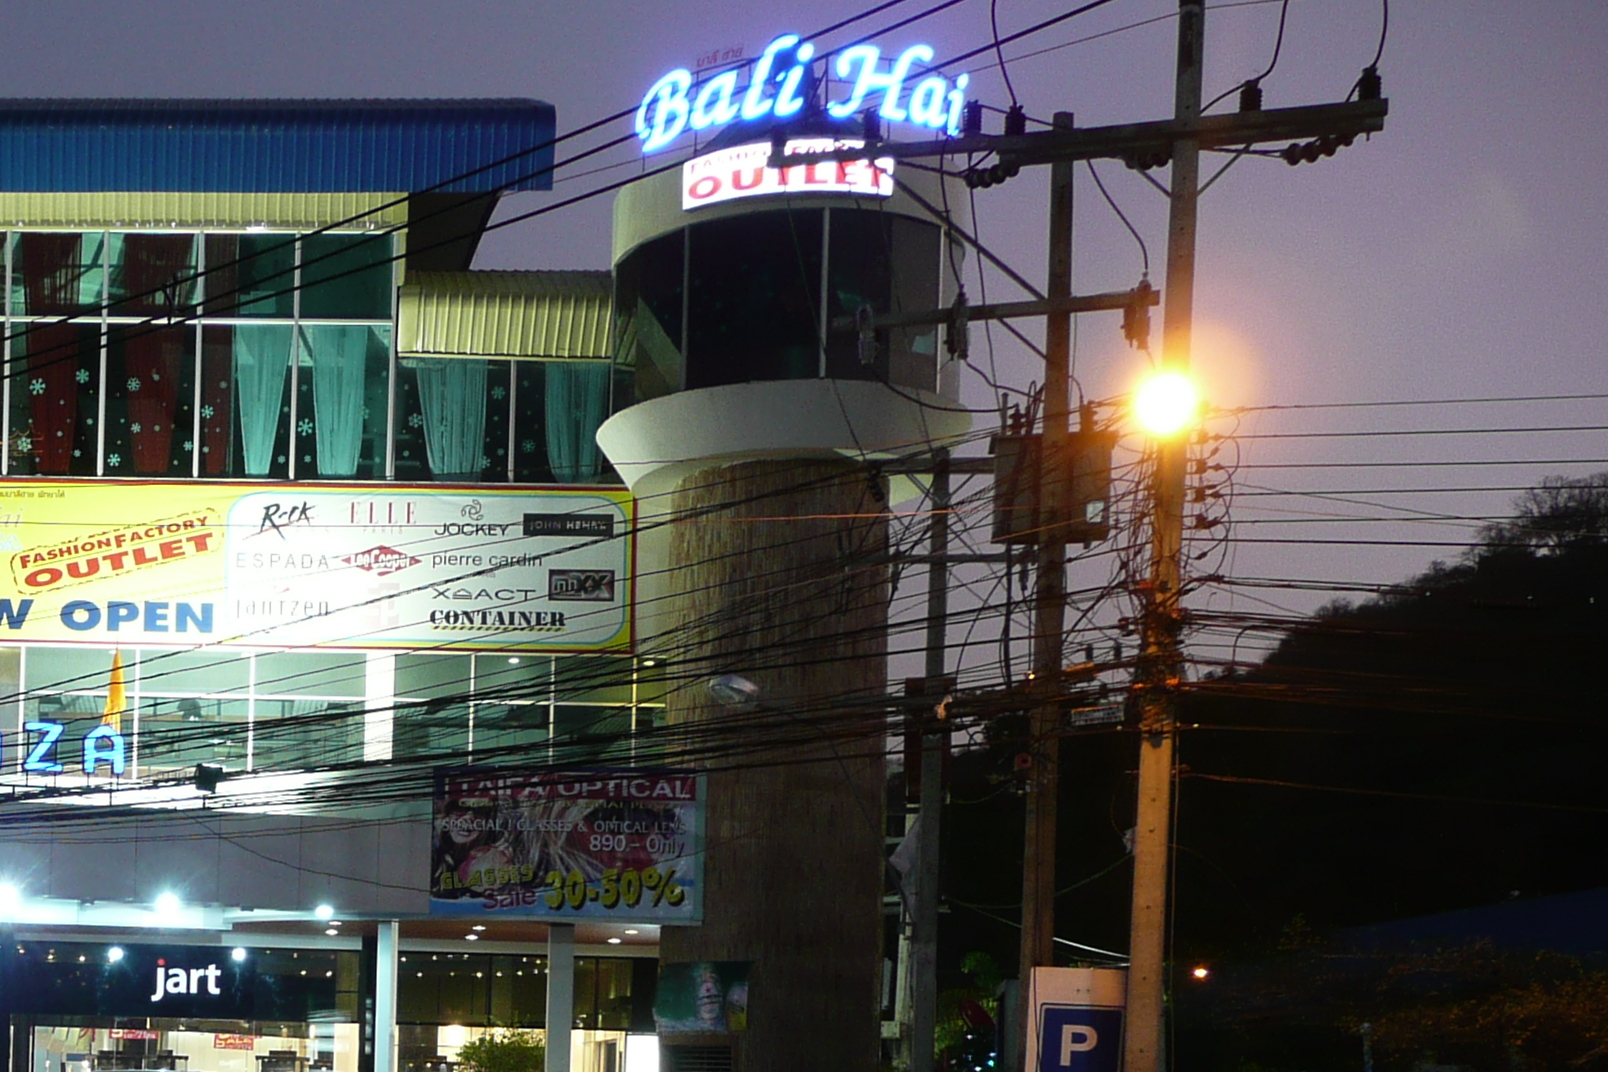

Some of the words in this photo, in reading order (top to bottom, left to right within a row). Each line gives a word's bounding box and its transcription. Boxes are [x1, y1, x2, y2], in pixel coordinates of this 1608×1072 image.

[635, 33, 815, 152] Bali
[827, 45, 969, 136] Hai
[435, 523, 510, 536] JOCKEY
[20, 535, 112, 569] FASHION
[115, 515, 210, 549] FACTORY
[24, 531, 214, 588] OUTLET
[236, 552, 330, 569] ESPADA
[432, 551, 483, 568] pierre
[488, 552, 542, 568] cardin
[60, 600, 214, 633] OPEN
[429, 609, 566, 627] CONTAINER
[558, 777, 692, 799] OPTICAL
[517, 820, 572, 832] GLASSES
[594, 821, 649, 834] OPTICAL
[646, 834, 684, 857] Only
[440, 865, 535, 890] GLASSES
[545, 867, 685, 911] 30-50%
[482, 888, 538, 910] Sale
[151, 958, 221, 1002] jart
[1060, 1024, 1099, 1067] P
